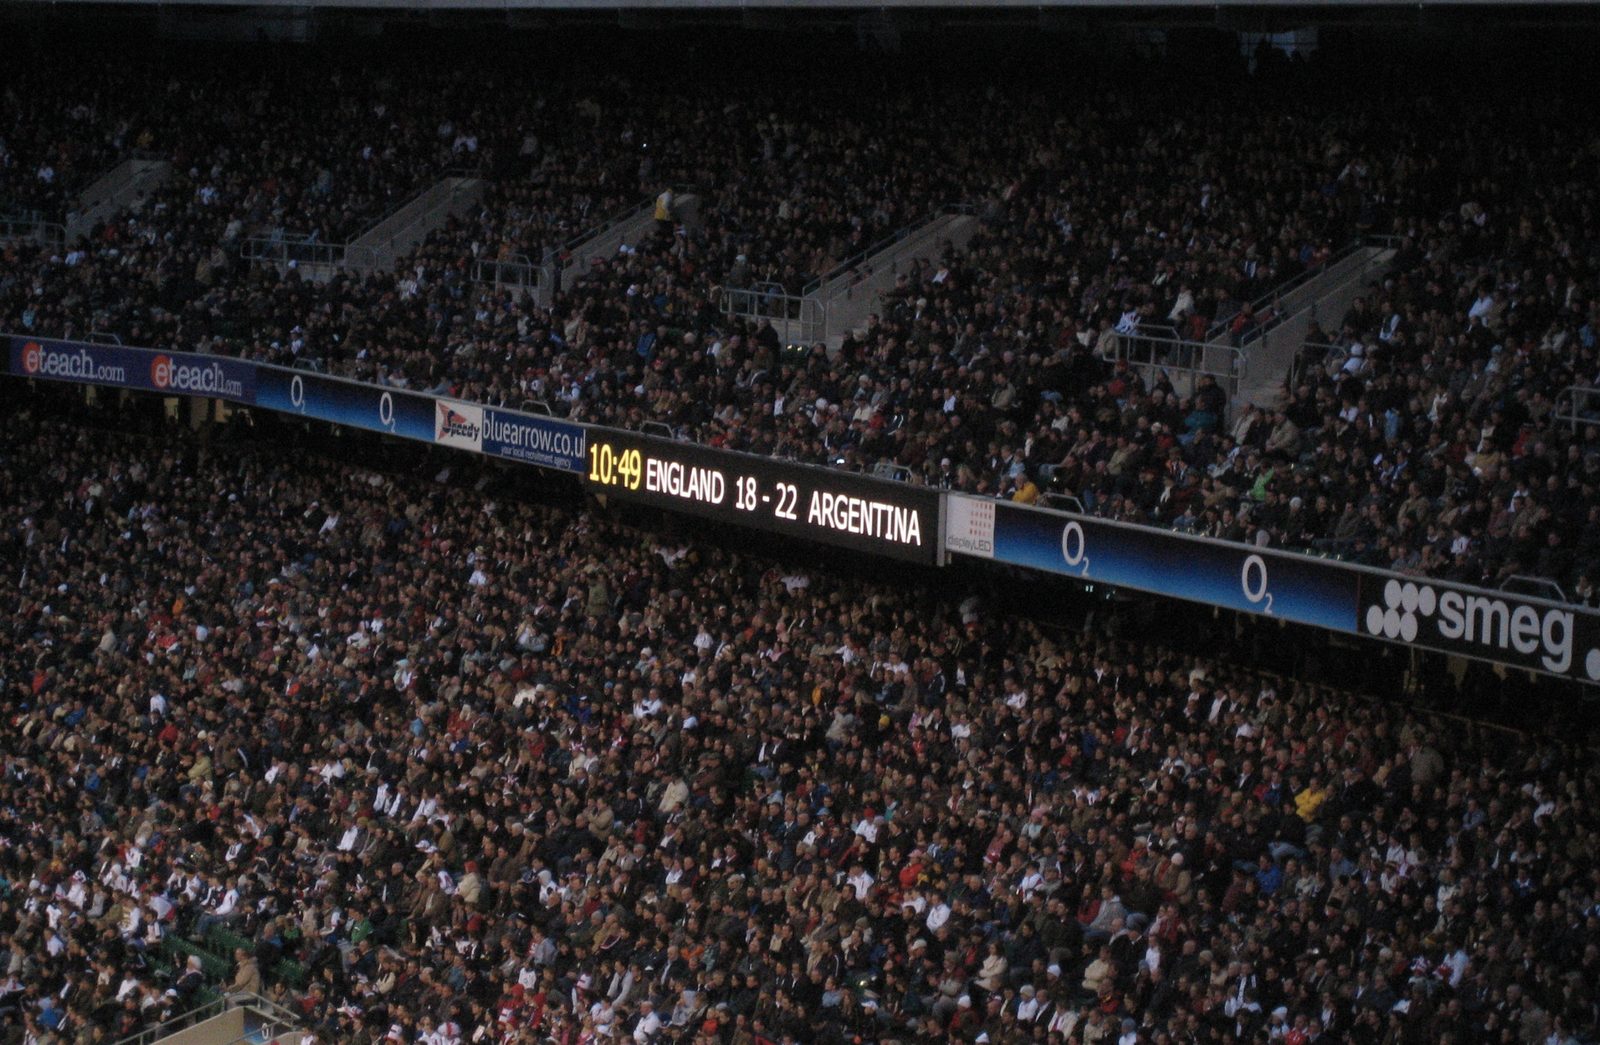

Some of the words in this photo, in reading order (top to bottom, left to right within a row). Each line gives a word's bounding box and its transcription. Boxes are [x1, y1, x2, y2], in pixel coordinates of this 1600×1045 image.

[25, 348, 125, 383] eteach.com
[154, 357, 243, 397] eteach.com
[442, 409, 480, 442] Speedy
[589, 443, 642, 491] 10:49
[646, 458, 725, 505] ENGLAND
[735, 475, 757, 511] 18
[775, 482, 798, 521] 22
[808, 490, 921, 546] ARGENTINA
[1438, 591, 1574, 673] smeg
